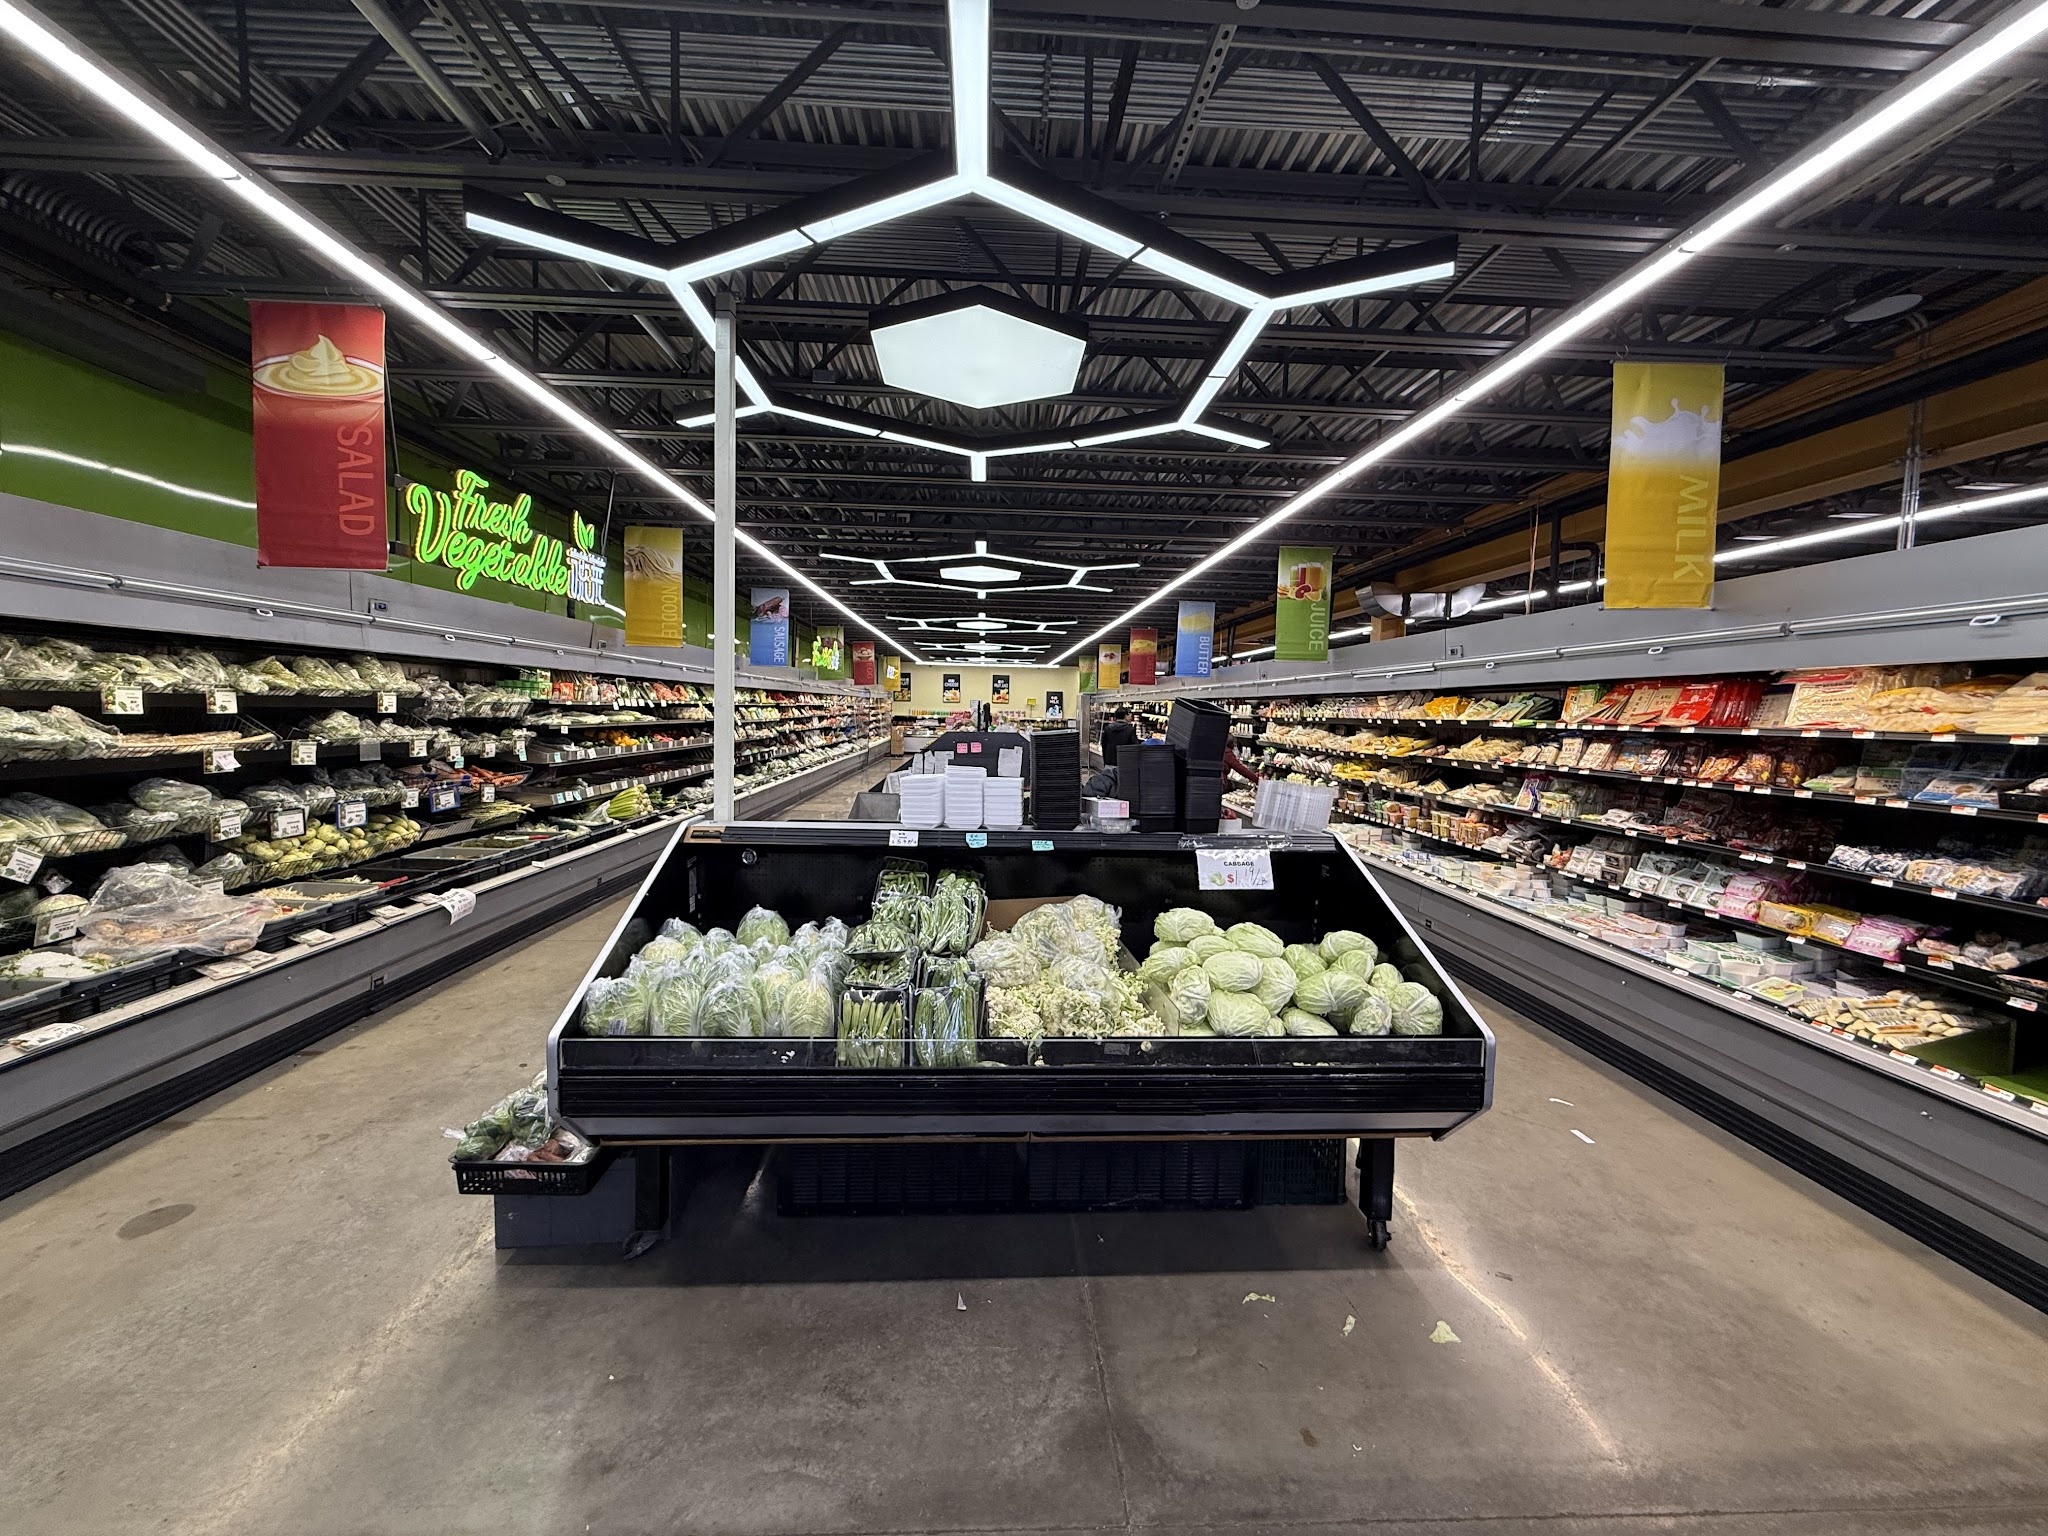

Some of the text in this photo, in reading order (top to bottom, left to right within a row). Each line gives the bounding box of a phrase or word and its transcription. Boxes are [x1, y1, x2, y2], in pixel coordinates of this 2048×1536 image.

[337, 423, 374, 536] SALAD
[452, 469, 533, 544] Fresh
[406, 483, 569, 595] Vegetable
[1675, 475, 1709, 579] MILK
[661, 584, 678, 638] NOODLE
[1308, 601, 1326, 651] JUICE
[773, 625, 785, 663] SAUSAGE
[1197, 636, 1211, 674] BUTTER
